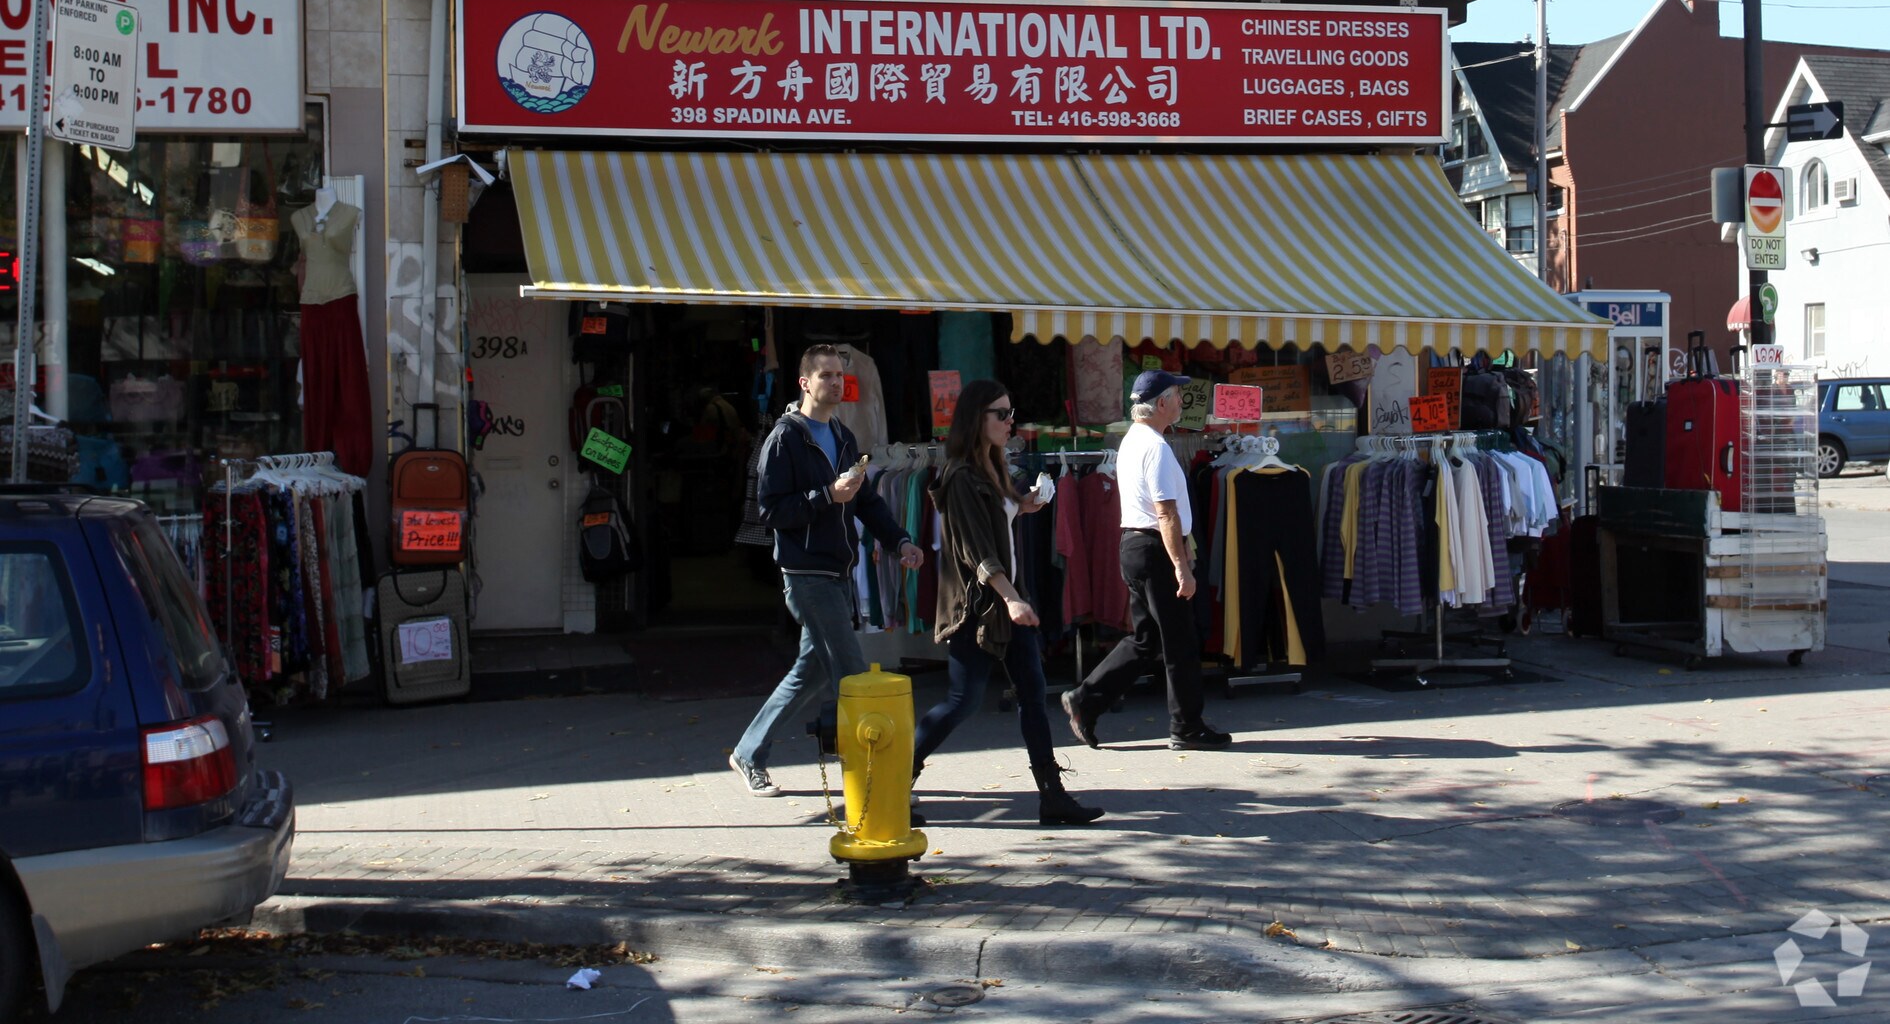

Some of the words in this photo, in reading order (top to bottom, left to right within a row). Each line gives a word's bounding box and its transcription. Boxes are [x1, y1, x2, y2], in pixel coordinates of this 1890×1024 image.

[60, 6, 97, 23] ENFORCED
[617, 2, 784, 56] Newark
[800, 8, 1127, 60] INTERNATIONAL
[1140, 15, 1221, 60] LTD.
[1241, 19, 1321, 37] CHINESE
[1326, 21, 1410, 38] DRESSES
[73, 45, 100, 63] 8:00
[102, 51, 121, 68] AM
[1241, 49, 1345, 66] TRAVELLING
[1349, 50, 1409, 67] GOODS
[89, 67, 105, 83] TO
[669, 59, 1178, 106] 新方舟國際貿易有限公司
[73, 84, 99, 101] 9:00
[101, 89, 119, 105] PM
[1359, 80, 1410, 96] BAGS
[671, 107, 707, 124] 398
[713, 108, 801, 124] SPADINA
[806, 109, 852, 125] AVE.
[1012, 111, 1053, 126] TEL:
[1058, 111, 1181, 128] 416-598-3668
[1243, 109, 1297, 125] BRIEF
[1376, 111, 1428, 127] GIFTS
[70, 127, 89, 137] TICKET
[100, 133, 115, 142] DASH
[1751, 238, 1763, 250] DO
[1765, 239, 1781, 250] NOT
[1755, 253, 1779, 264] ENTER
[1608, 303, 1641, 325] Bell
[1755, 347, 1783, 364] LOOK
